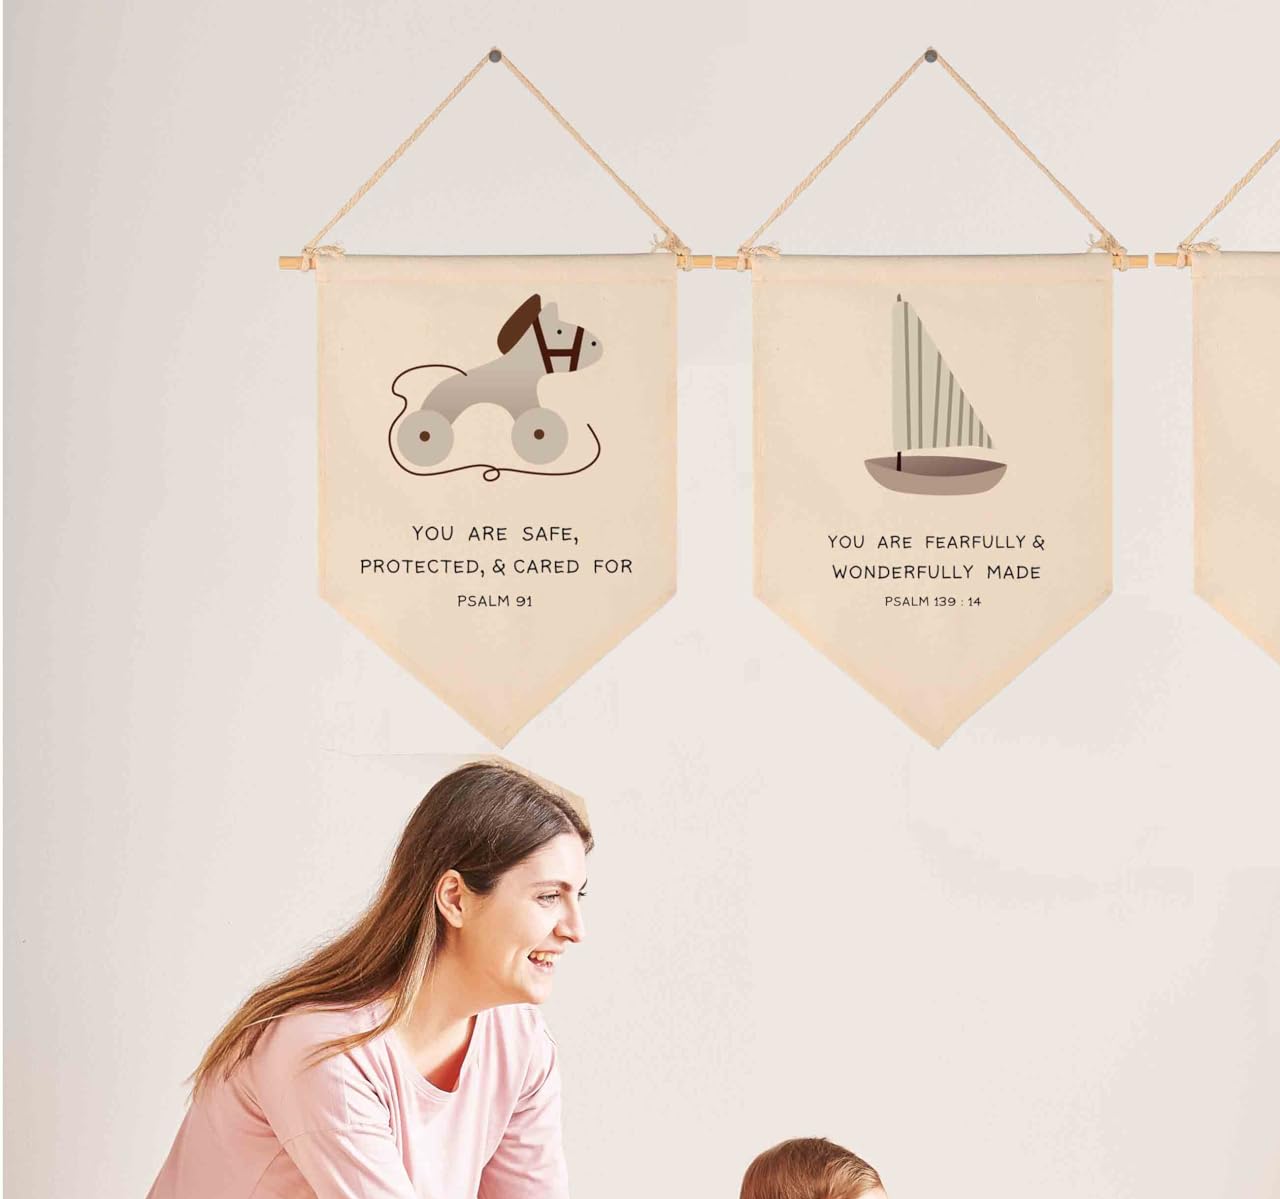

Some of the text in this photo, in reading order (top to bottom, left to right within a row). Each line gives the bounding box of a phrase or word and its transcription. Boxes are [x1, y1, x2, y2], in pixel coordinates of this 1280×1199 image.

[412, 525, 579, 546] YOU ARE SAFE,
[827, 534, 1045, 551] YOU ARE FEARFULLY &
[360, 558, 633, 578] PROTECTED, & CARED FOR
[832, 564, 1041, 580] WONDERFULLY MADE
[457, 594, 532, 607] PSALM 91
[884, 596, 929, 607] PSALM
